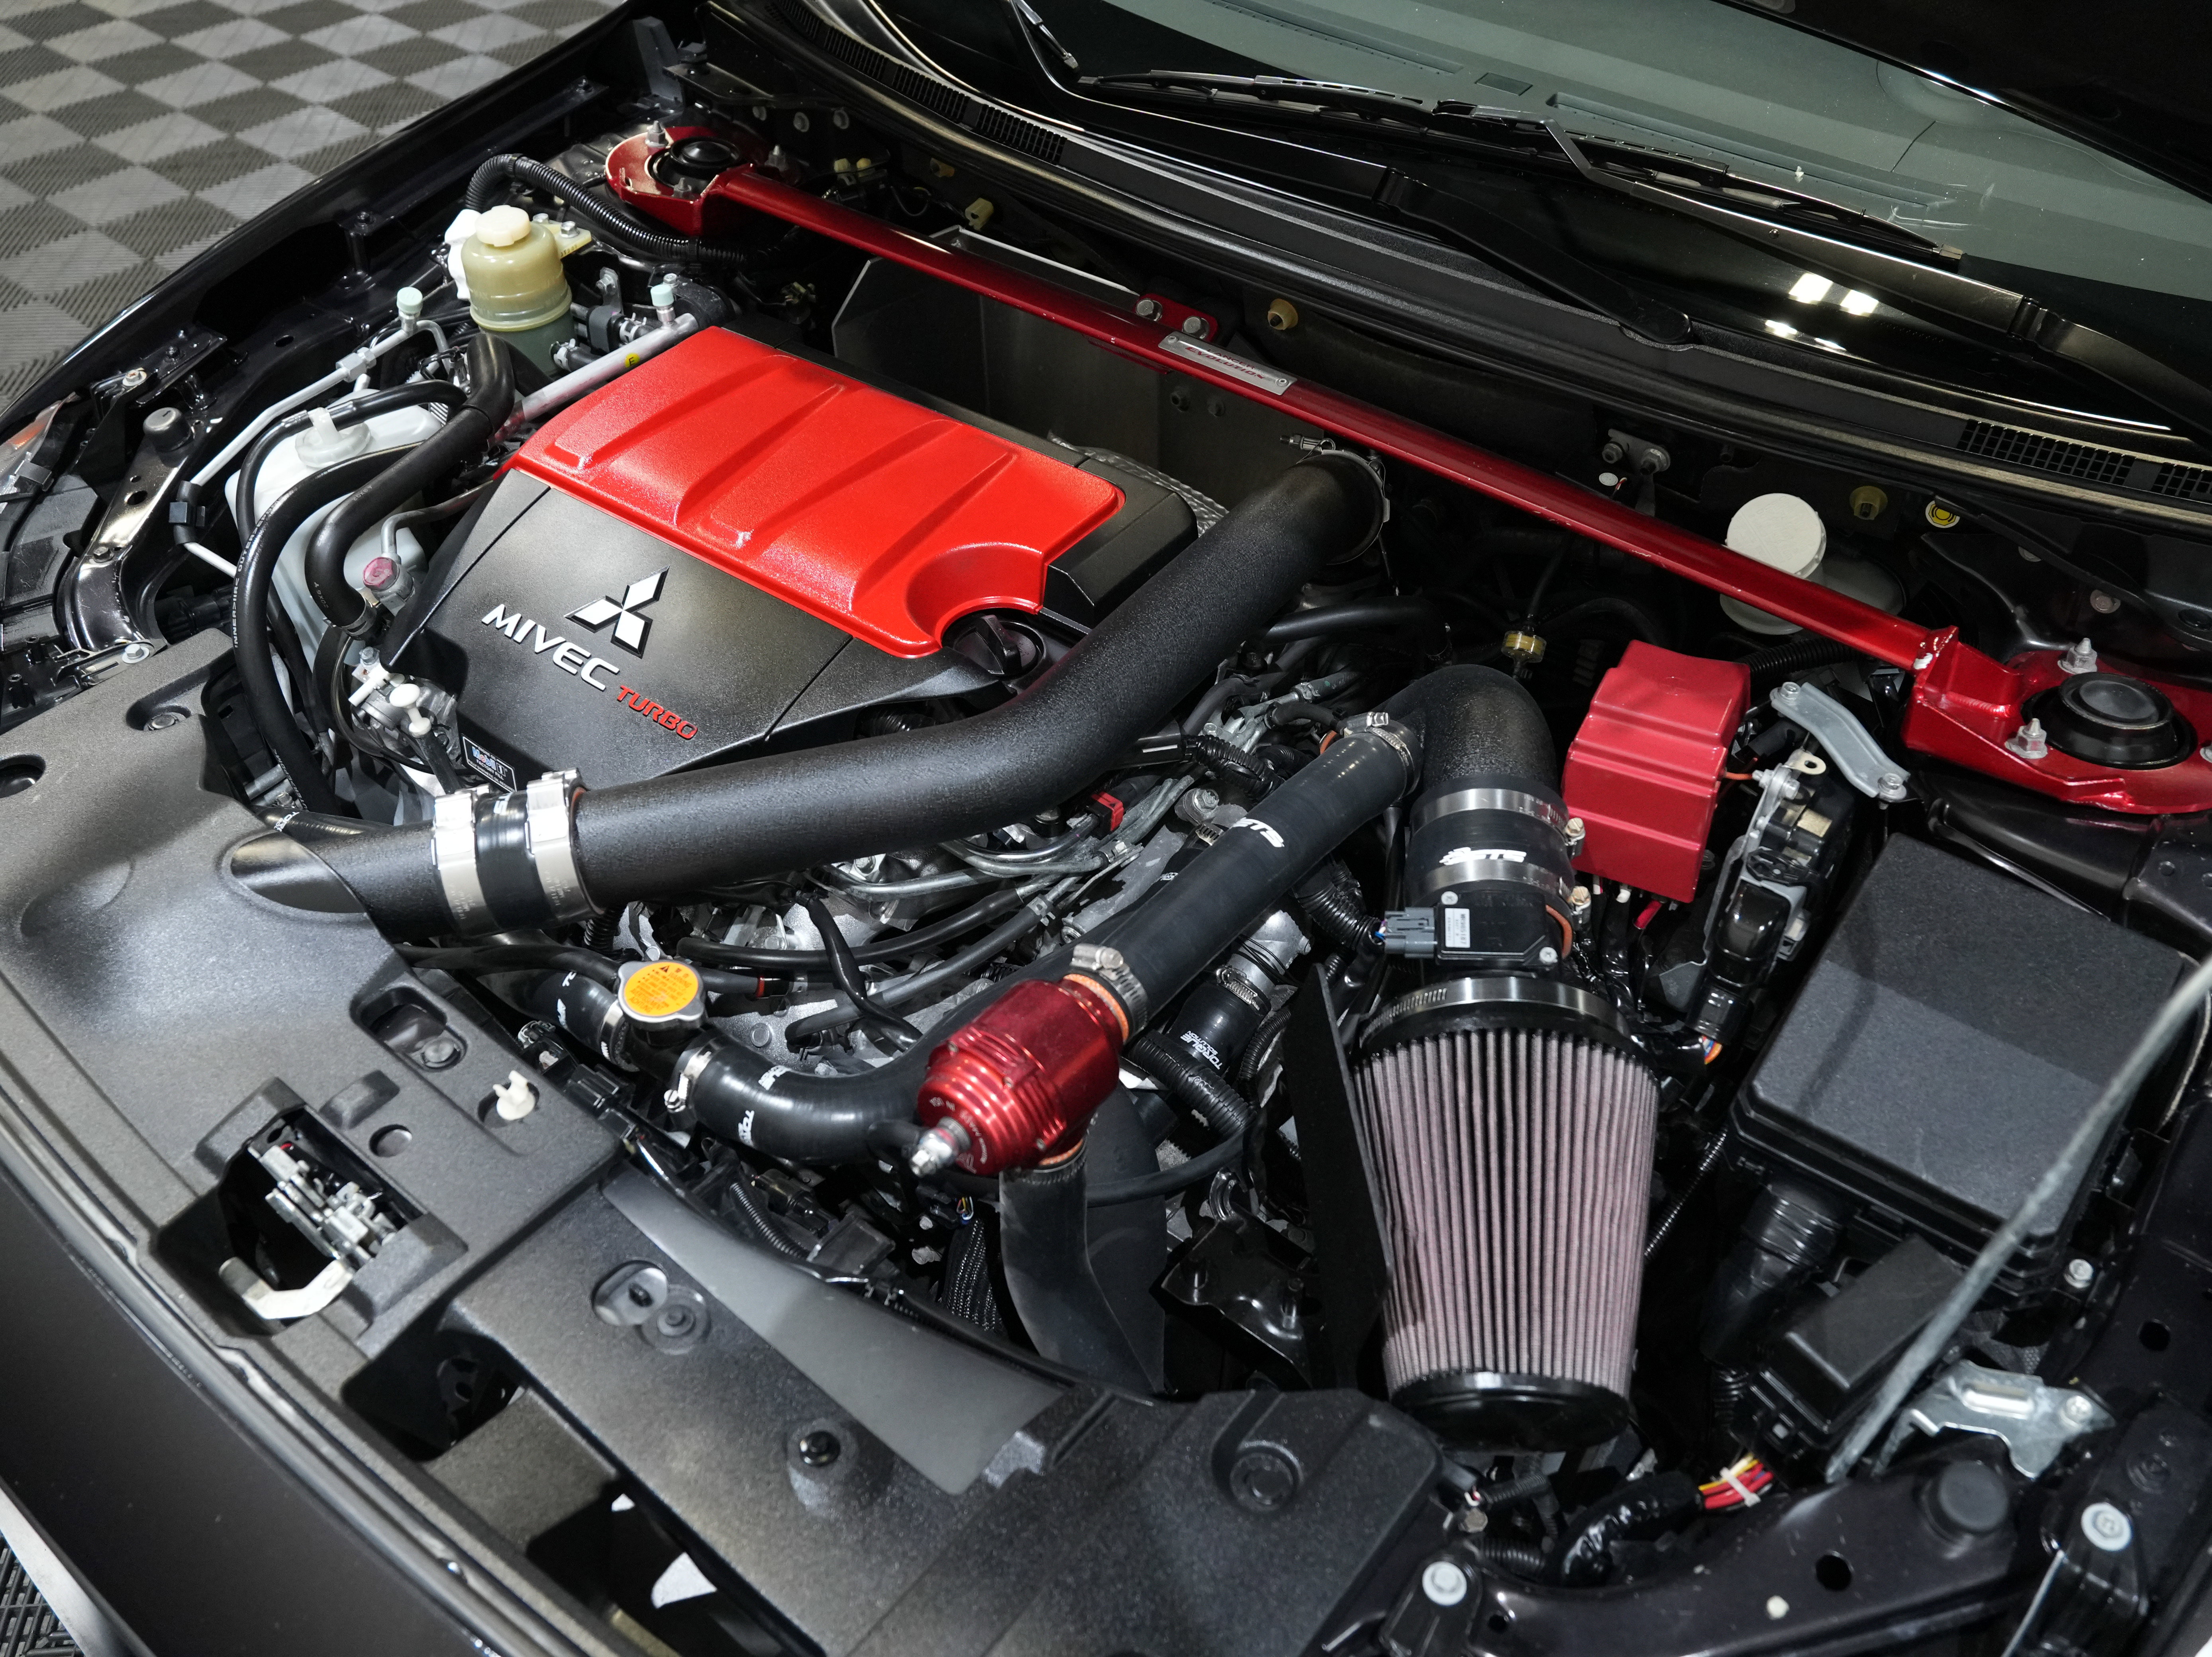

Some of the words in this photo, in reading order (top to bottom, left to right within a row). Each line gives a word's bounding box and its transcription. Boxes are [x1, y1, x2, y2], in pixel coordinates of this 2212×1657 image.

[1185, 347, 1265, 379] EVOLUTION
[1206, 349, 1255, 369] LANCER
[481, 604, 620, 691] MIVEC
[616, 685, 698, 740] TURBO
[472, 746, 497, 771] Mobil
[476, 759, 495, 774] FACTORY
[494, 771, 504, 781] FILL
[1180, 1033, 1223, 1070] TORQUE
[1187, 1030, 1218, 1056] SOLUTION
